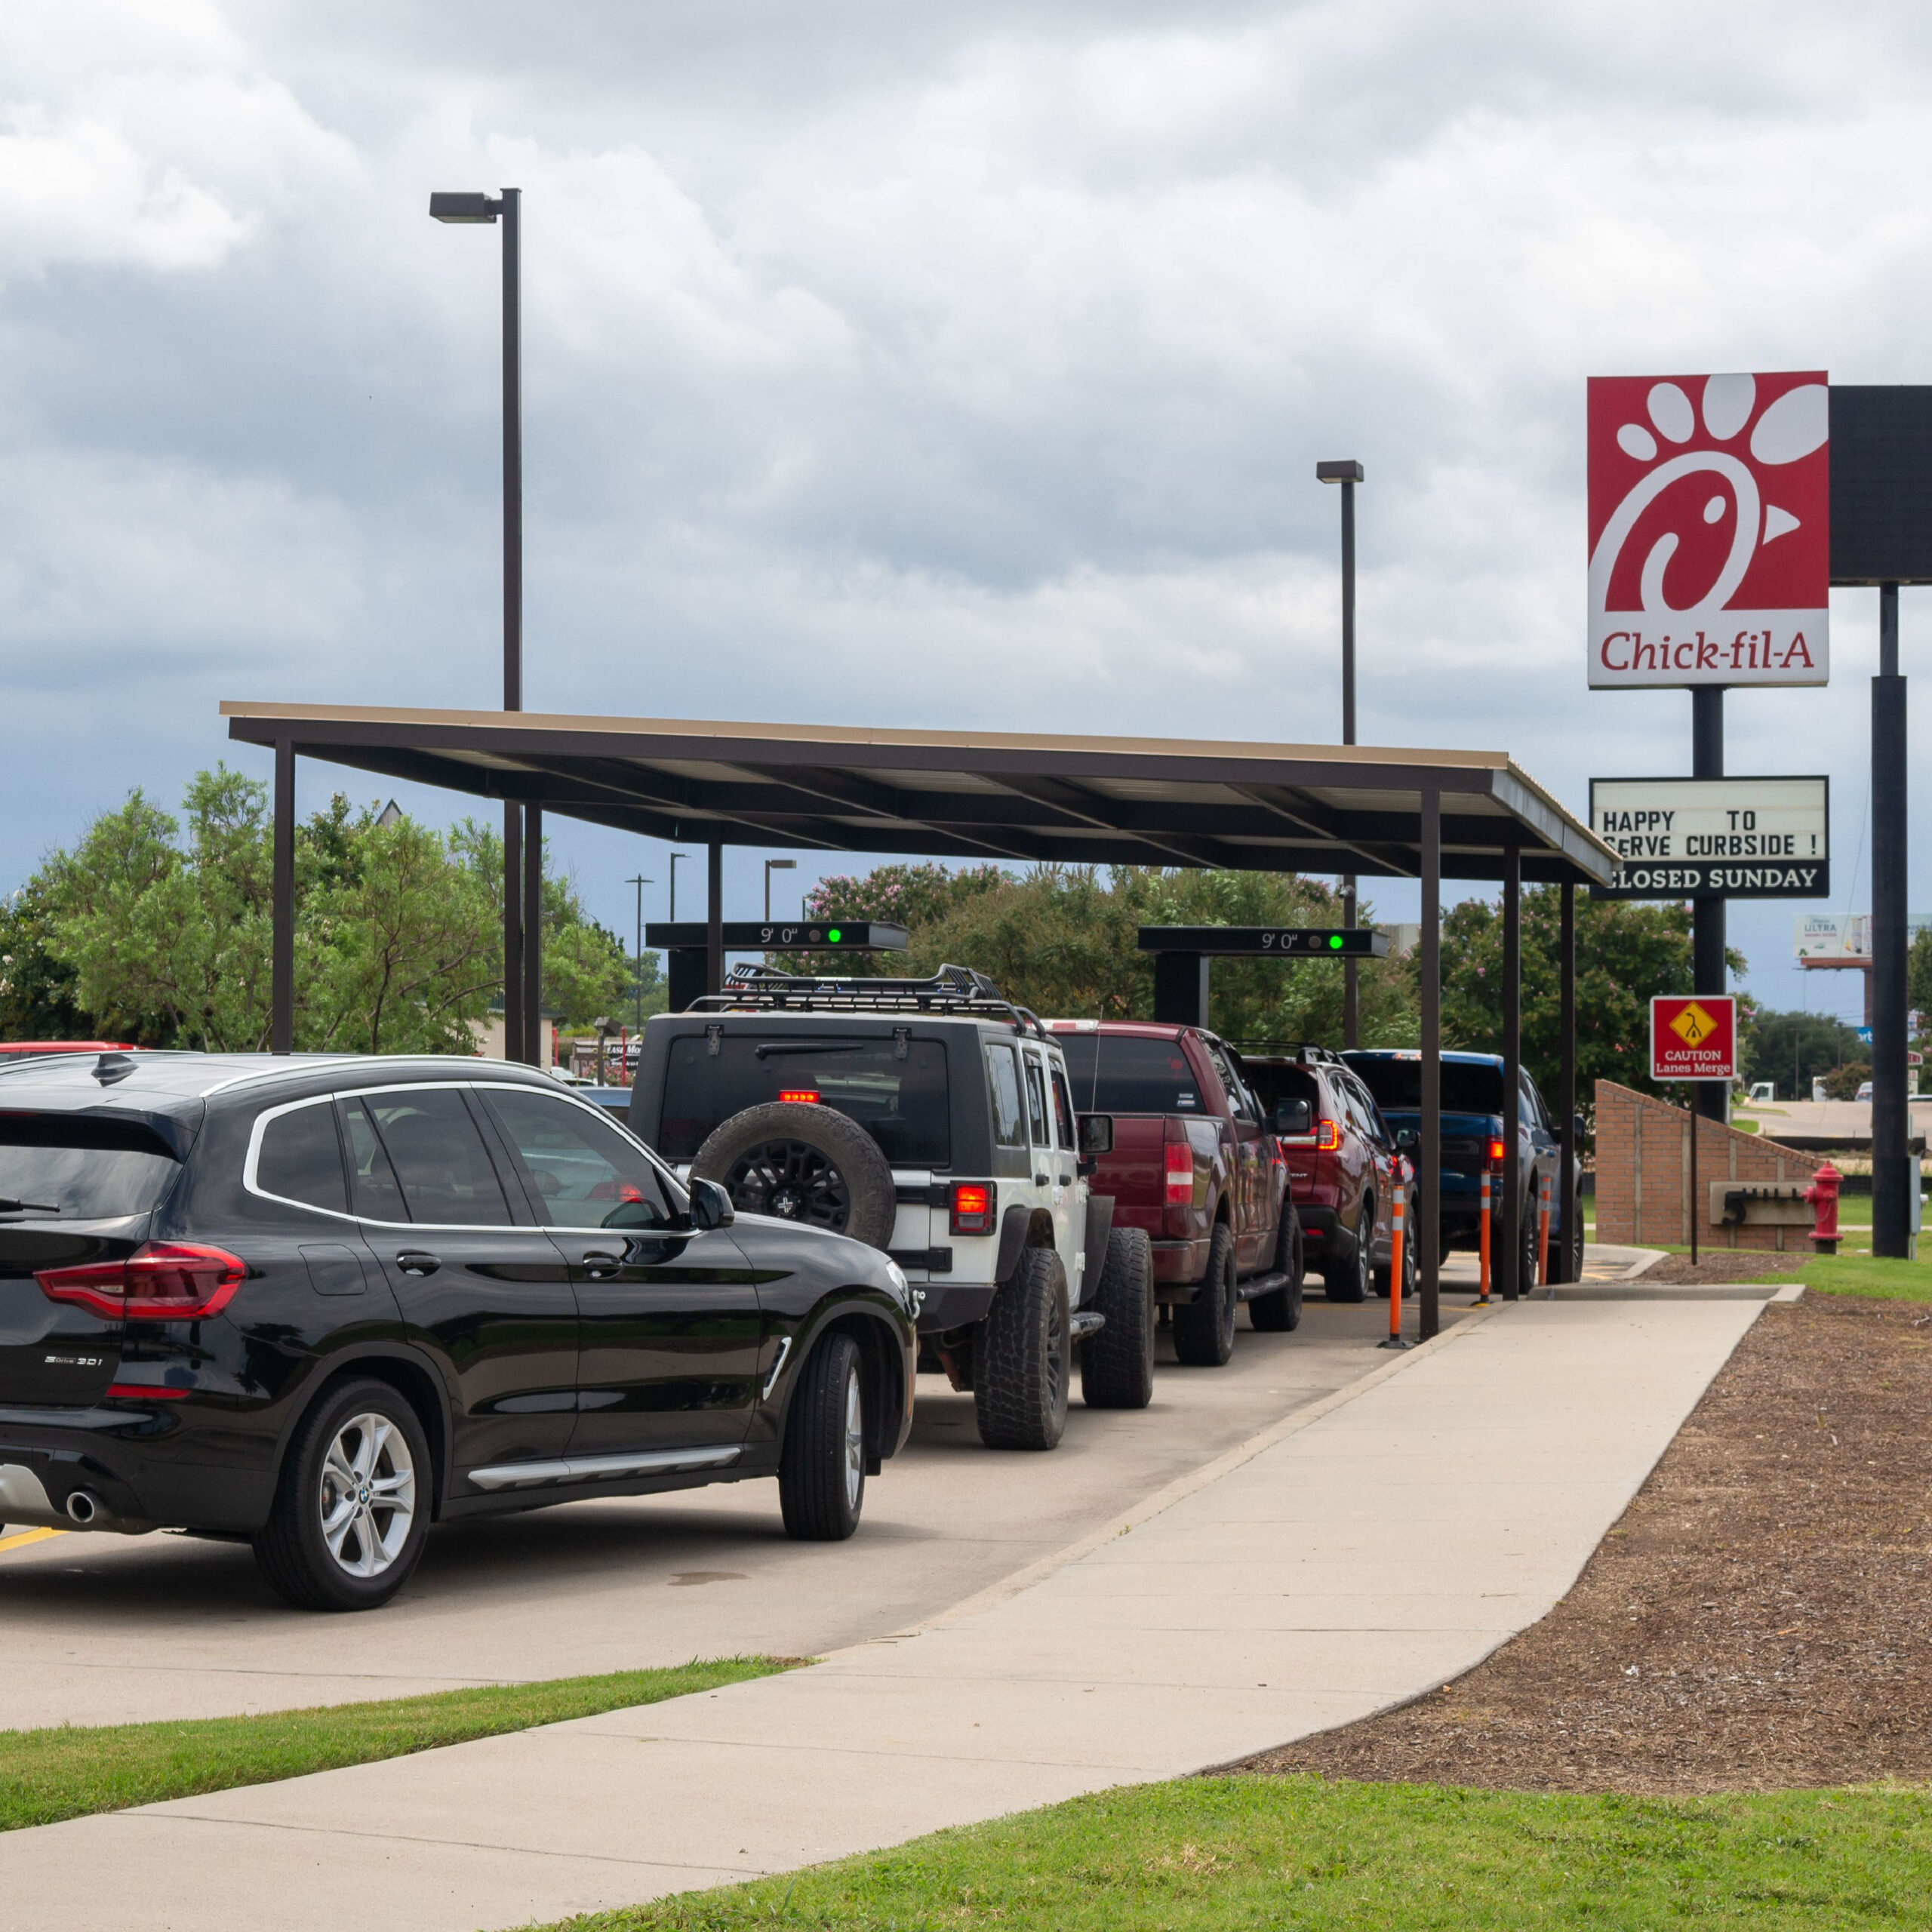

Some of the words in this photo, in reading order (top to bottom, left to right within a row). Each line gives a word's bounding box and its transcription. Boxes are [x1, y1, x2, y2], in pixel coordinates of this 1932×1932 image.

[1601, 631, 1814, 671] Chick-fil-A
[1603, 811, 1675, 832] HAPPY
[1727, 811, 1756, 831] TO
[1686, 834, 1795, 856] CURBSIDE
[1709, 868, 1818, 888] SUNDAY
[1804, 924, 1837, 932] ULTRA
[1665, 1051, 1721, 1061] CAUTION
[1656, 1063, 1691, 1073] Lanes
[1694, 1063, 1731, 1076] Merge
